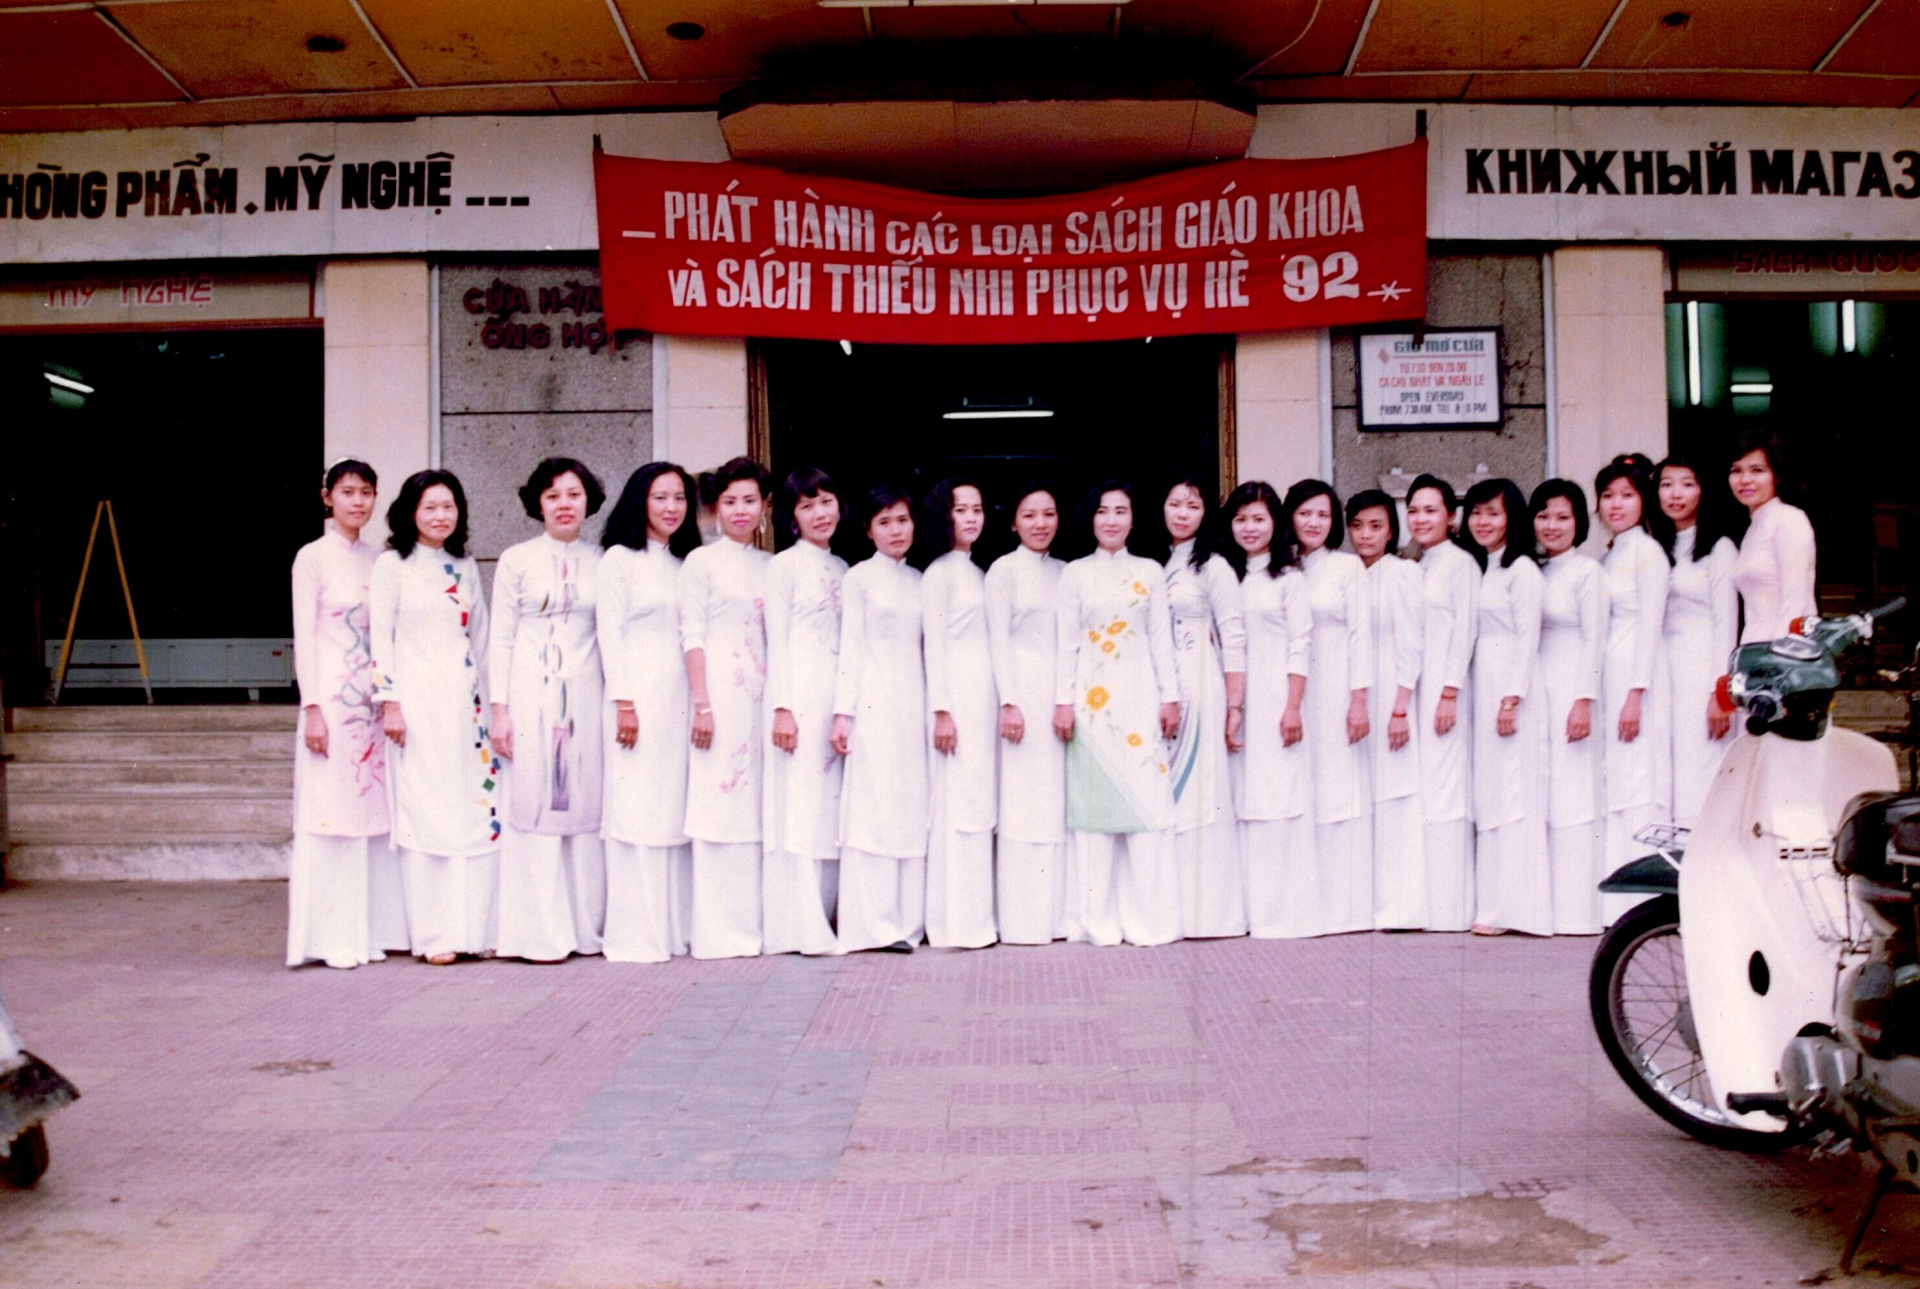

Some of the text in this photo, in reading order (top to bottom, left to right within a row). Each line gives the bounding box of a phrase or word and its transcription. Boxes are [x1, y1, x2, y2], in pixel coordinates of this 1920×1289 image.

[265, 155, 335, 212] MỸ
[342, 151, 455, 215] NGHỆ
[1465, 141, 1737, 196] КНИЖНЫЙ
[664, 179, 1364, 263] PHÁT HÀNH CÁC LOẠI SÁCH GIÁO KHOA
[667, 257, 708, 307] VÀ
[716, 246, 812, 311] SÁCH
[823, 255, 936, 315] THIẾU
[949, 268, 1014, 316] NHI
[1026, 266, 1129, 323] PHỤC
[1139, 262, 1189, 319] VỤ
[1204, 248, 1250, 310] HÈ
